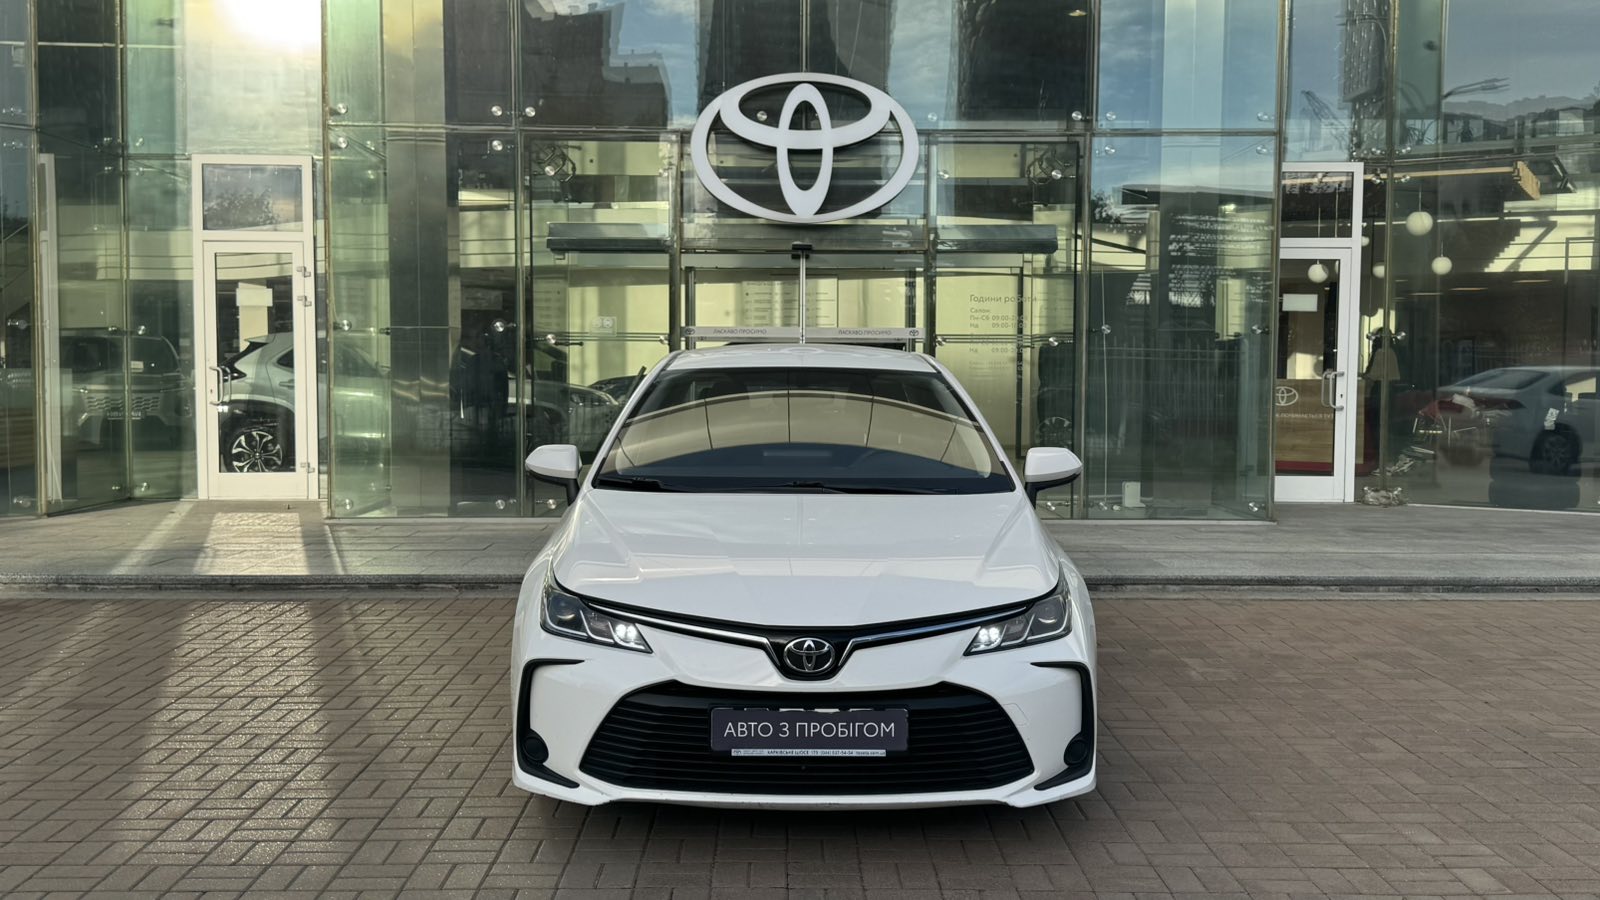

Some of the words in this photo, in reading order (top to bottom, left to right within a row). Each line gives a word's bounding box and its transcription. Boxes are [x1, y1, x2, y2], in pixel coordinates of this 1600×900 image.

[969, 294, 1002, 303] Години
[723, 722, 774, 738] АВТО
[779, 722, 790, 738] З
[796, 722, 895, 738] ПРОБІГОМ
